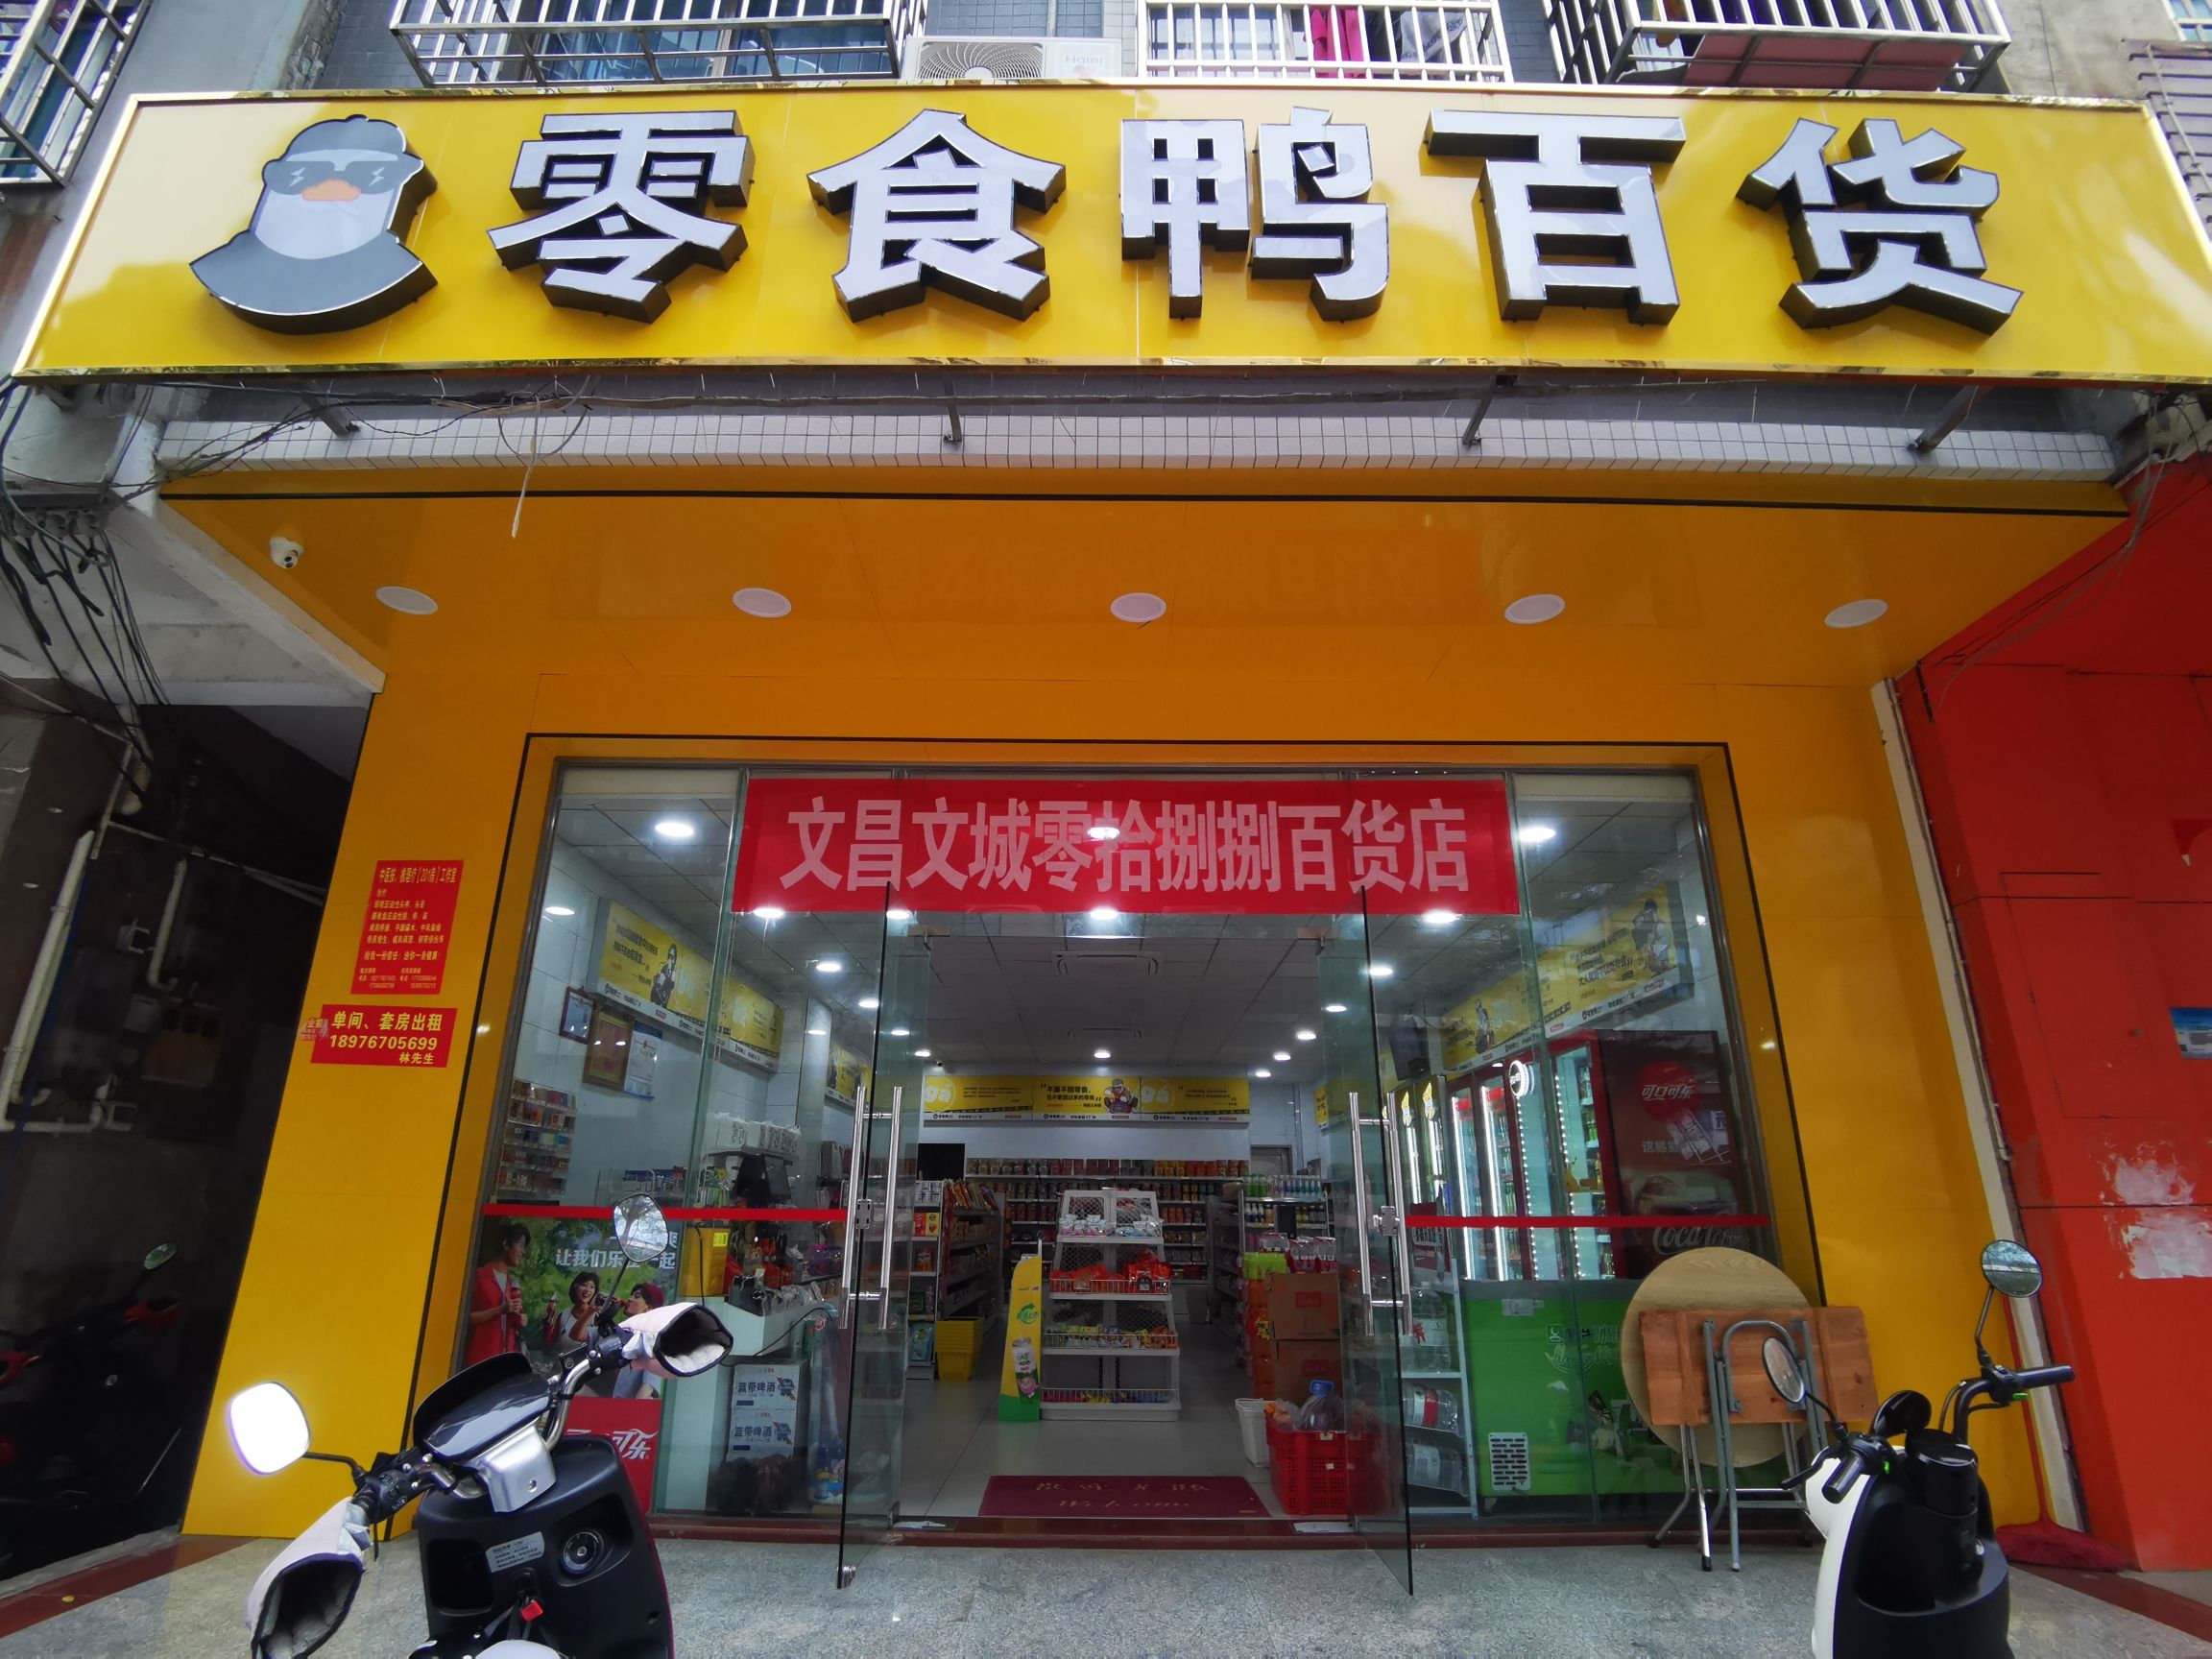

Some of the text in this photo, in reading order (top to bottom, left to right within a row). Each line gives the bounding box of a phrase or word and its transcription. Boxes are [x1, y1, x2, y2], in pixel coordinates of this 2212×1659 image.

[1065, 54, 1105, 64] Haier
[486, 108, 2024, 332] 零食鸭百货
[780, 796, 1469, 893] 文昌文城零拾捌捌百货店
[331, 1011, 443, 1031] 单间、套房出租
[329, 1034, 438, 1050] 18976705699
[399, 1052, 434, 1065] 林先生
[1642, 1084, 1695, 1101] 可口可乐
[557, 1249, 675, 1268] 让我们乐一起
[737, 1381, 776, 1393] 蓝带啤酒
[733, 1426, 772, 1438] 蓝带啤酒
